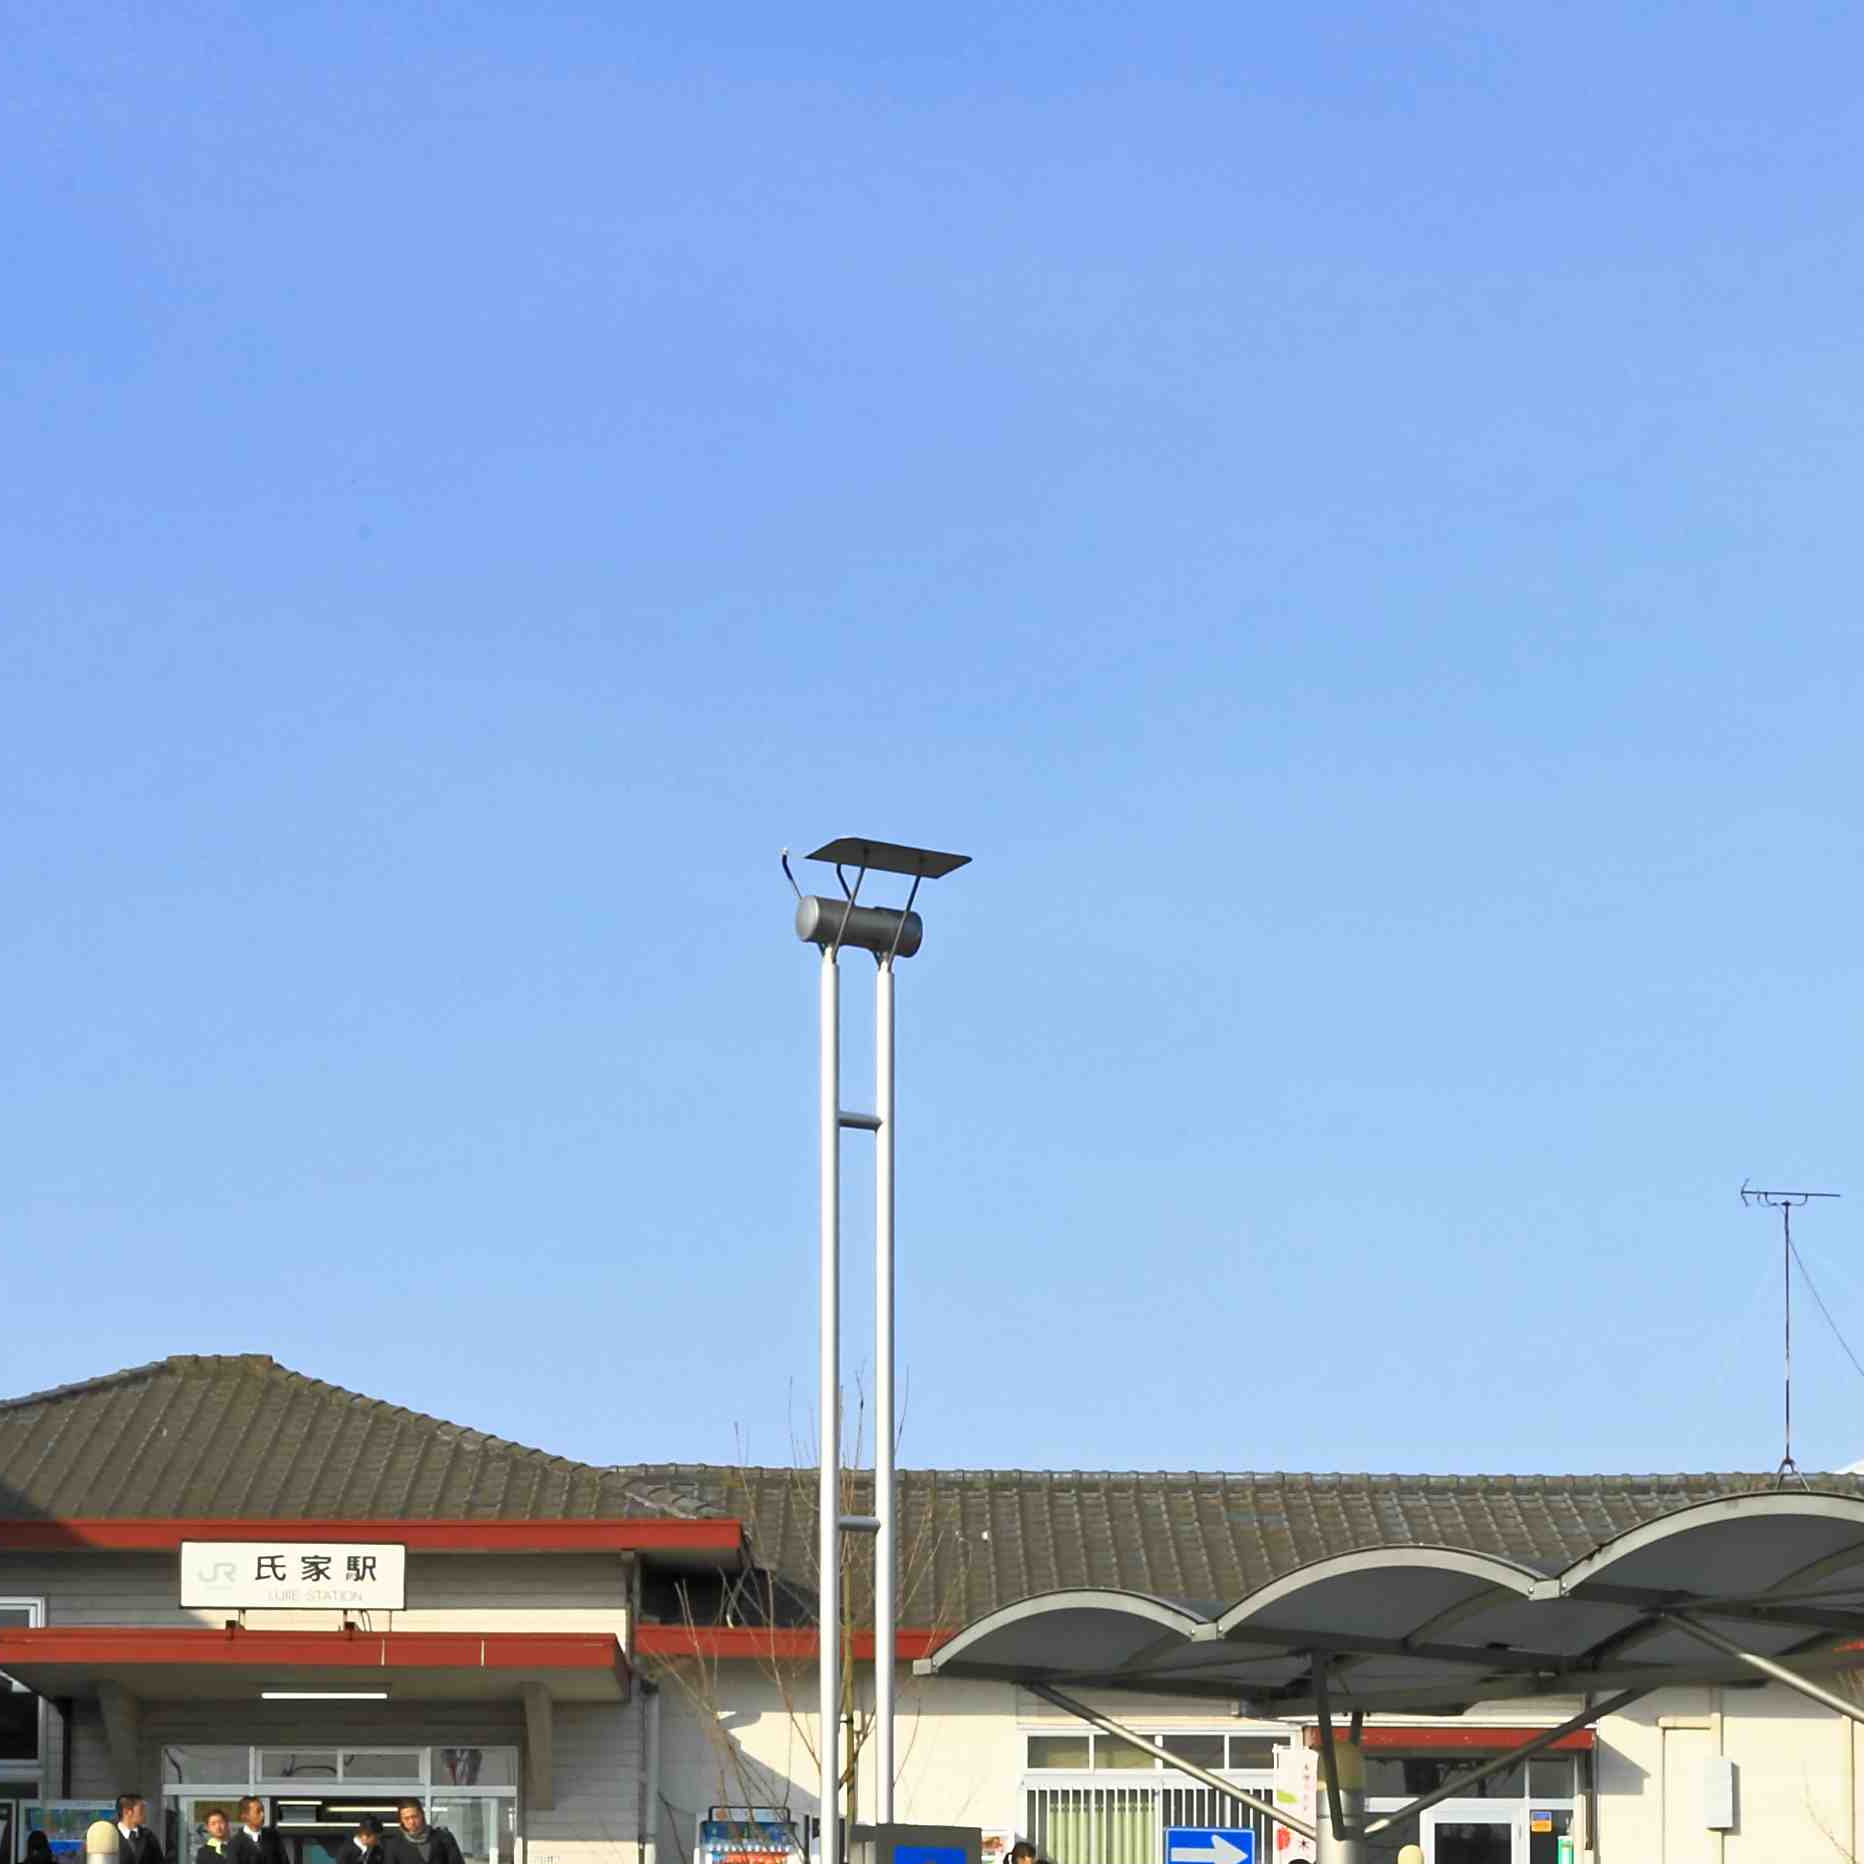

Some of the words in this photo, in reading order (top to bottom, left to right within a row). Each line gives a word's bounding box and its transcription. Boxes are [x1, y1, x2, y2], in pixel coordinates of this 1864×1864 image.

[198, 1562, 236, 1583] JR
[255, 1554, 377, 1582] 氏家駅
[306, 1590, 363, 1601] STATION
